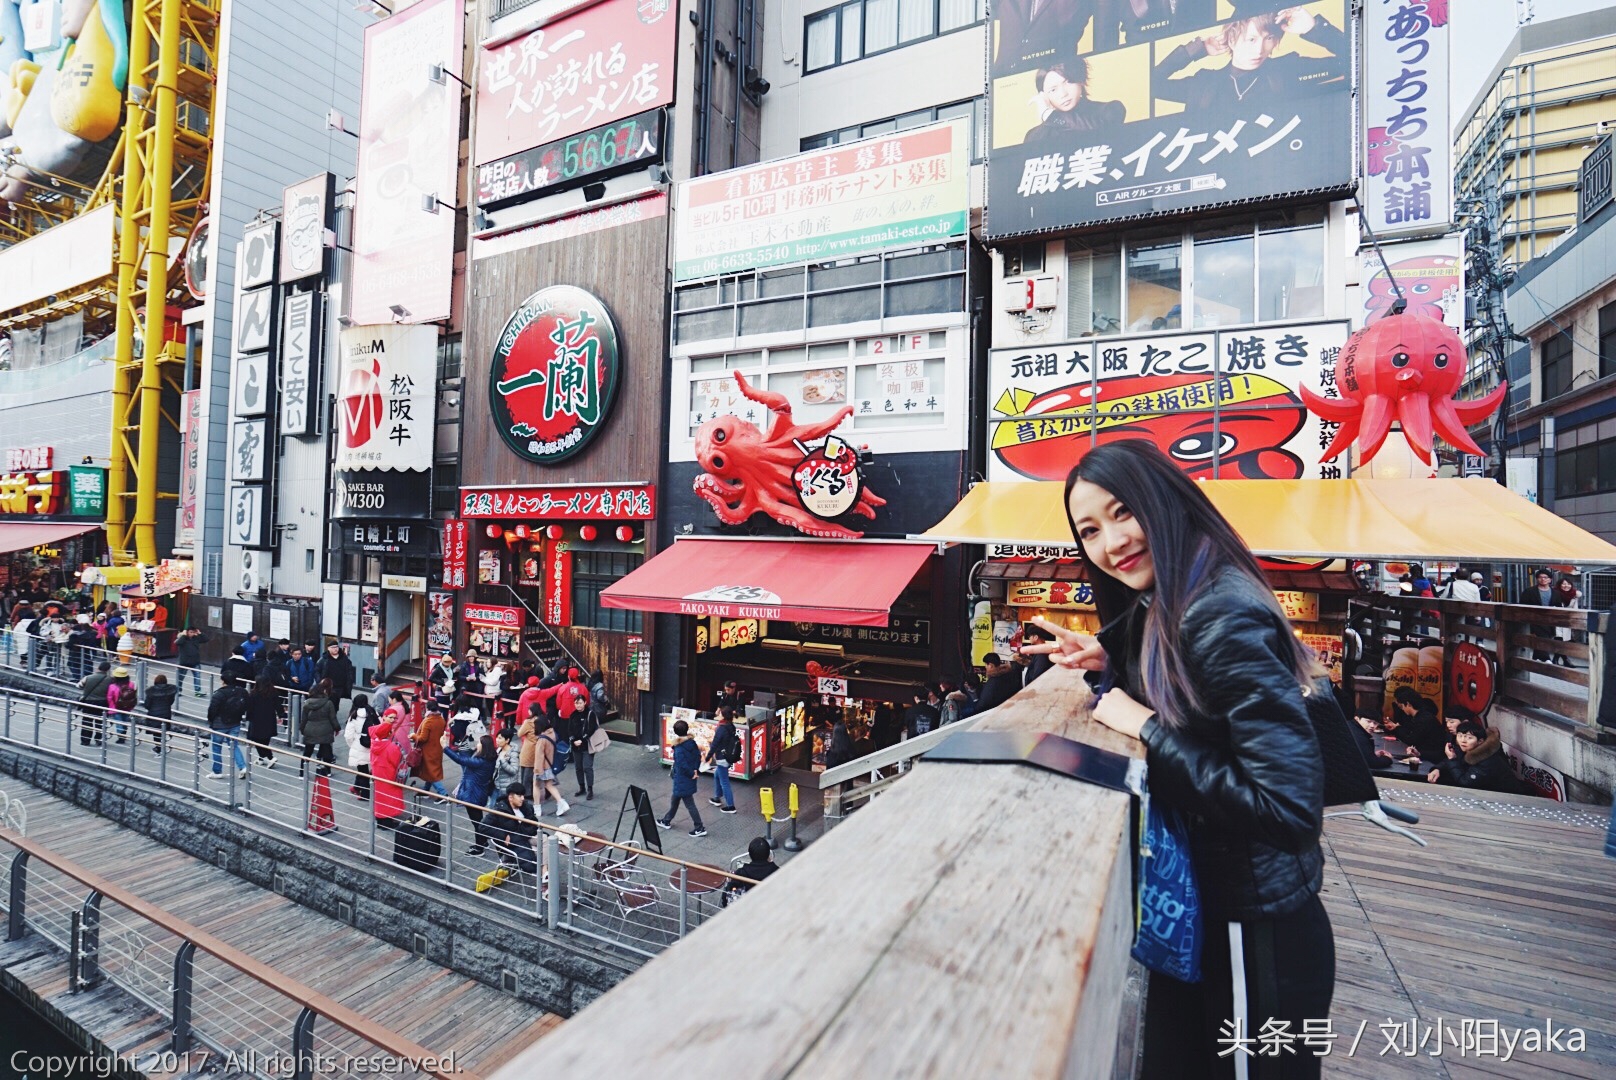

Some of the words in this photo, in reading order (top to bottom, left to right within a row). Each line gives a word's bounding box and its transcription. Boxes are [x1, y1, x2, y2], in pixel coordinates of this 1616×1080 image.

[1140, 20, 1170, 31] RYOSEI
[485, 29, 586, 94] 世界一
[1021, 49, 1056, 60] NATSUME
[506, 42, 627, 119] 人が訪れる
[1298, 72, 1329, 81] YOSHIKI
[538, 63, 660, 140] ラーメン店
[1384, 5, 1432, 225] あっちち本舗
[479, 162, 516, 182] 昨日の
[724, 155, 839, 200] 看板広告主
[854, 140, 904, 170] 募集
[1016, 113, 1303, 198] 職業、イケメン。
[479, 168, 550, 203] ご来店人数
[1115, 189, 1130, 201] AIR
[1131, 185, 1163, 198] グループ
[1164, 182, 1182, 194] 大阪
[1583, 158, 1612, 206] GOLD
[686, 264, 703, 275] TEL
[703, 245, 789, 273] 06-6633-5540
[796, 219, 951, 257] http://www.tamaki-est.co.jp
[500, 300, 553, 356] ICHIRAN
[285, 299, 310, 430] 旨くて安い
[497, 309, 601, 426] 一蘭
[389, 373, 415, 447] 松阪牛
[74, 472, 101, 493] 薬
[348, 483, 365, 492] SAKE
[367, 483, 384, 493] BAR
[347, 493, 385, 509] M300
[463, 489, 652, 516] 天然とんこつラーメン専門店
[680, 602, 730, 616] TAKO-YAKI
[738, 607, 781, 619] KUKURU
[992, 634, 1011, 645] Asah
[1417, 674, 1439, 684] sahi
